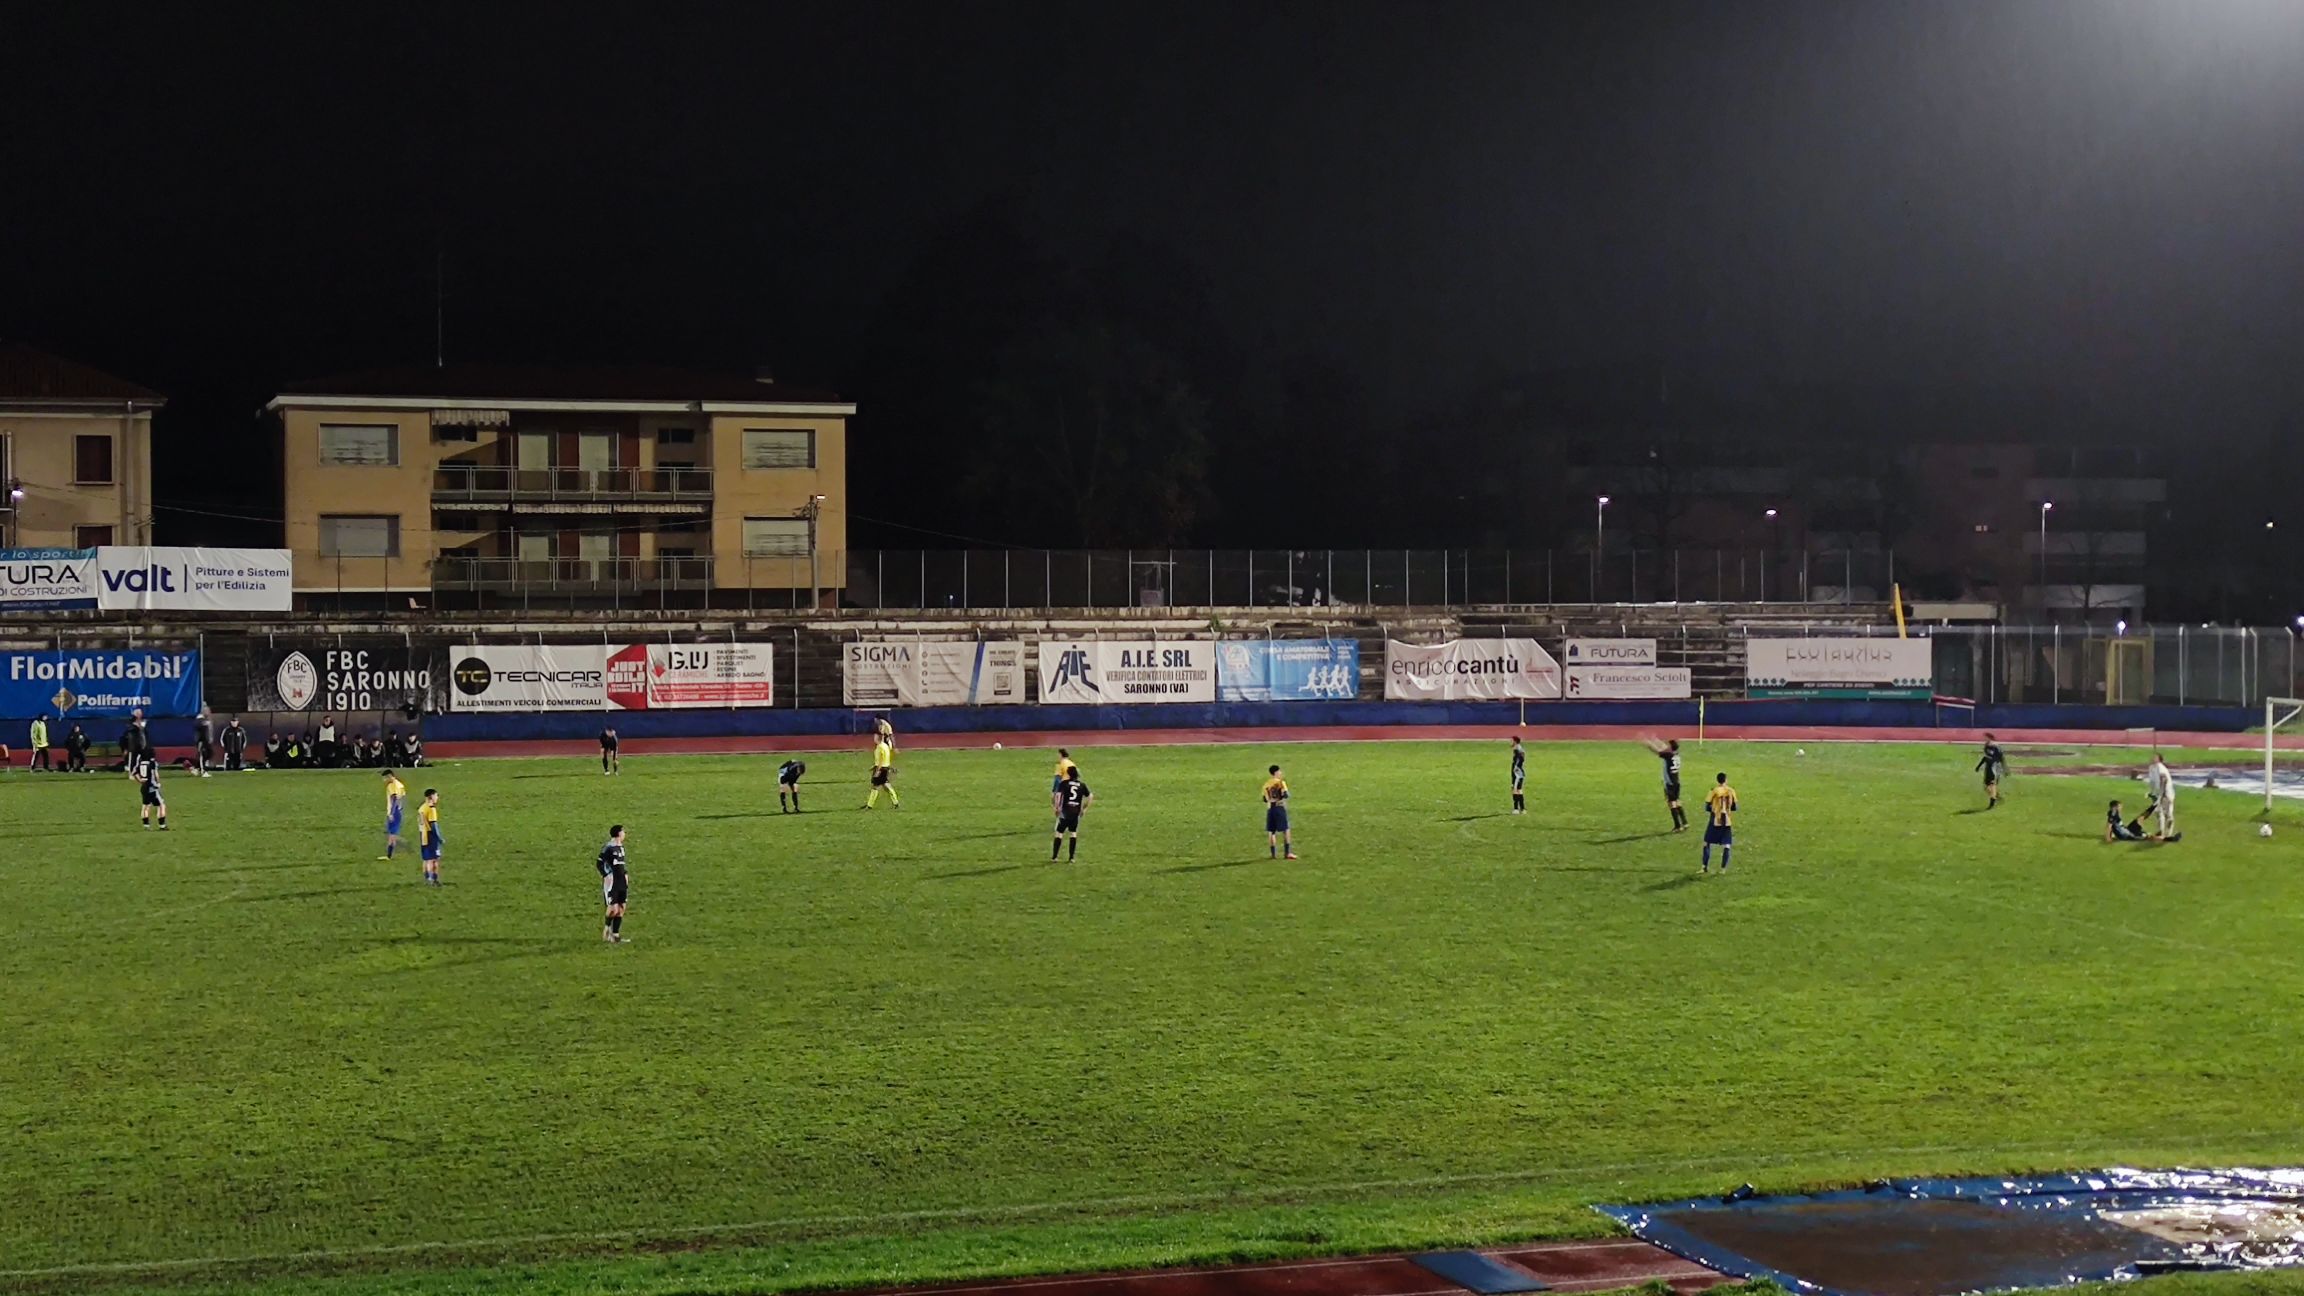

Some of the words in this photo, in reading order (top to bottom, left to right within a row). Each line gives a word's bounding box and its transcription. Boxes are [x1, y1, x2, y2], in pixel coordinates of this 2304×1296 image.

[102, 564, 175, 592] valt
[195, 567, 234, 578] Pitture
[237, 570, 244, 578] e
[247, 567, 290, 578] Sistemi
[10, 586, 88, 597] COSTRUZIONI
[195, 581, 213, 592] per
[217, 580, 266, 591] l'Edilizia
[326, 650, 369, 670] FBC
[851, 646, 911, 662] SIGMA
[1162, 650, 1192, 668] SRL
[1590, 648, 1648, 658] FUTURA
[287, 659, 308, 674] FBC
[326, 670, 431, 691] SARONNO
[456, 669, 488, 684] TC
[494, 671, 602, 683] TECNICAR
[1106, 671, 1136, 682] VERIFICA
[1137, 671, 1174, 682] CONTATORI
[1175, 670, 1207, 681] ELETTRICI
[1124, 683, 1167, 694] SARONNO
[1169, 683, 1189, 693] (VA)
[77, 693, 152, 707] Polifarma
[327, 692, 371, 711] 1910
[1069, 785, 1078, 800] 5
